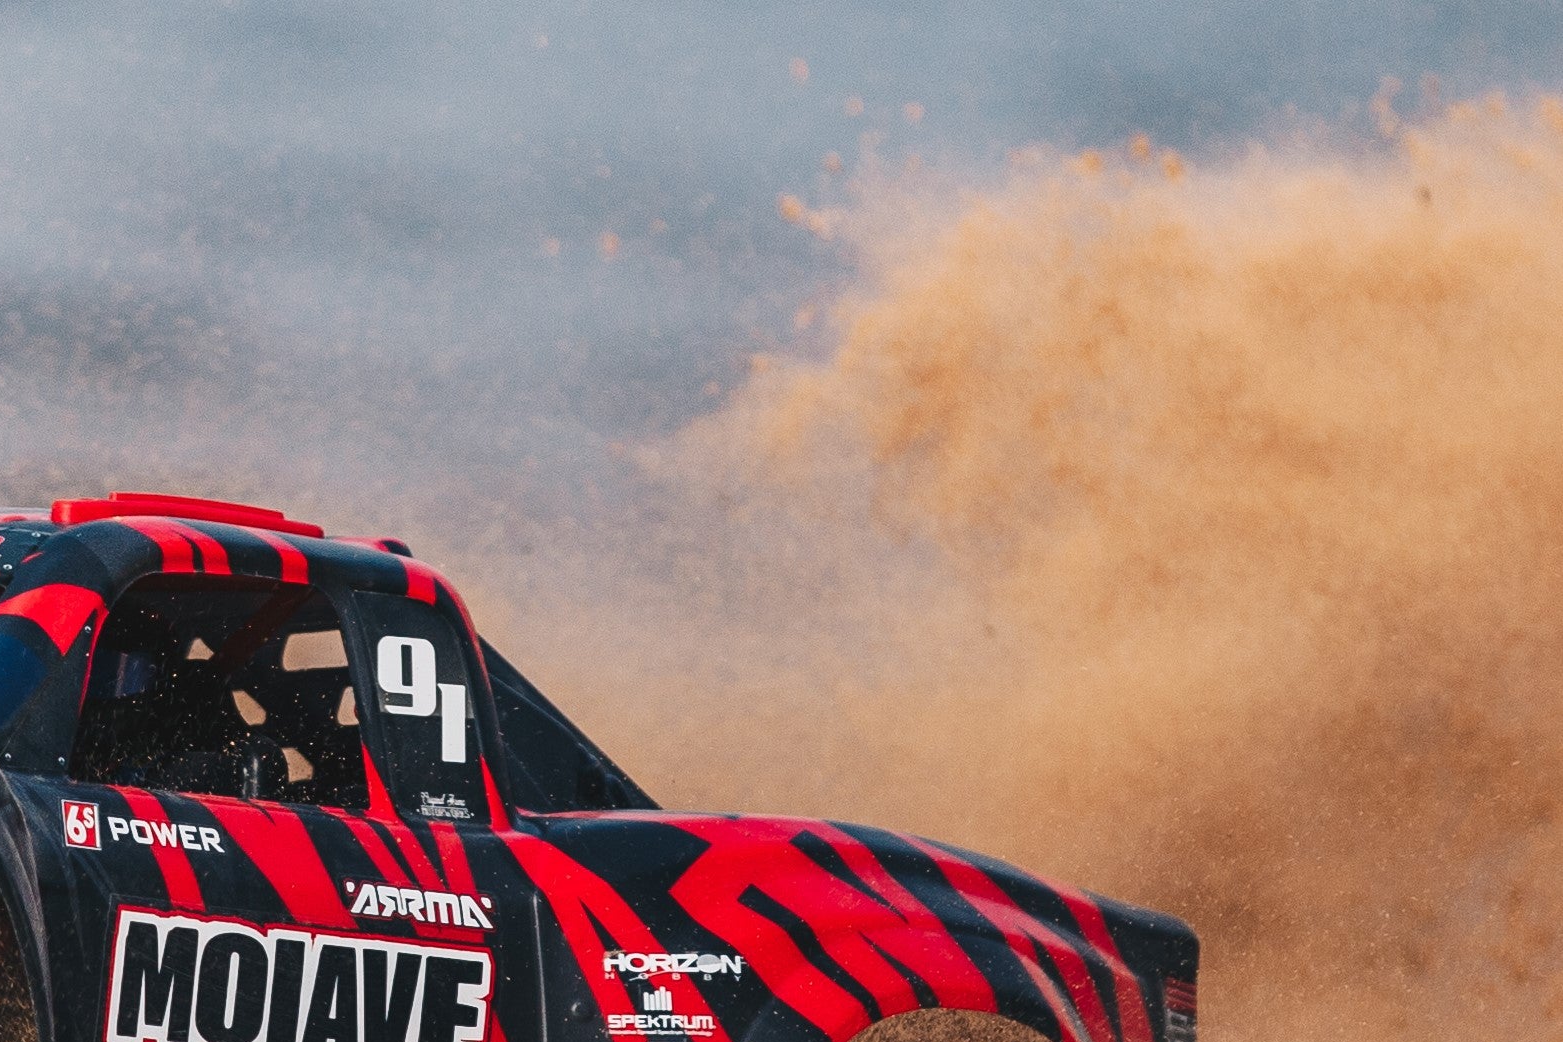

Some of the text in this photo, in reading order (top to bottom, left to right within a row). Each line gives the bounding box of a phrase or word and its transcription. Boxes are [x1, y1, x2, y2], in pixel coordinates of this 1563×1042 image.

[377, 636, 466, 763] 91
[107, 816, 225, 853] POWER
[603, 953, 742, 973] HORIZON
